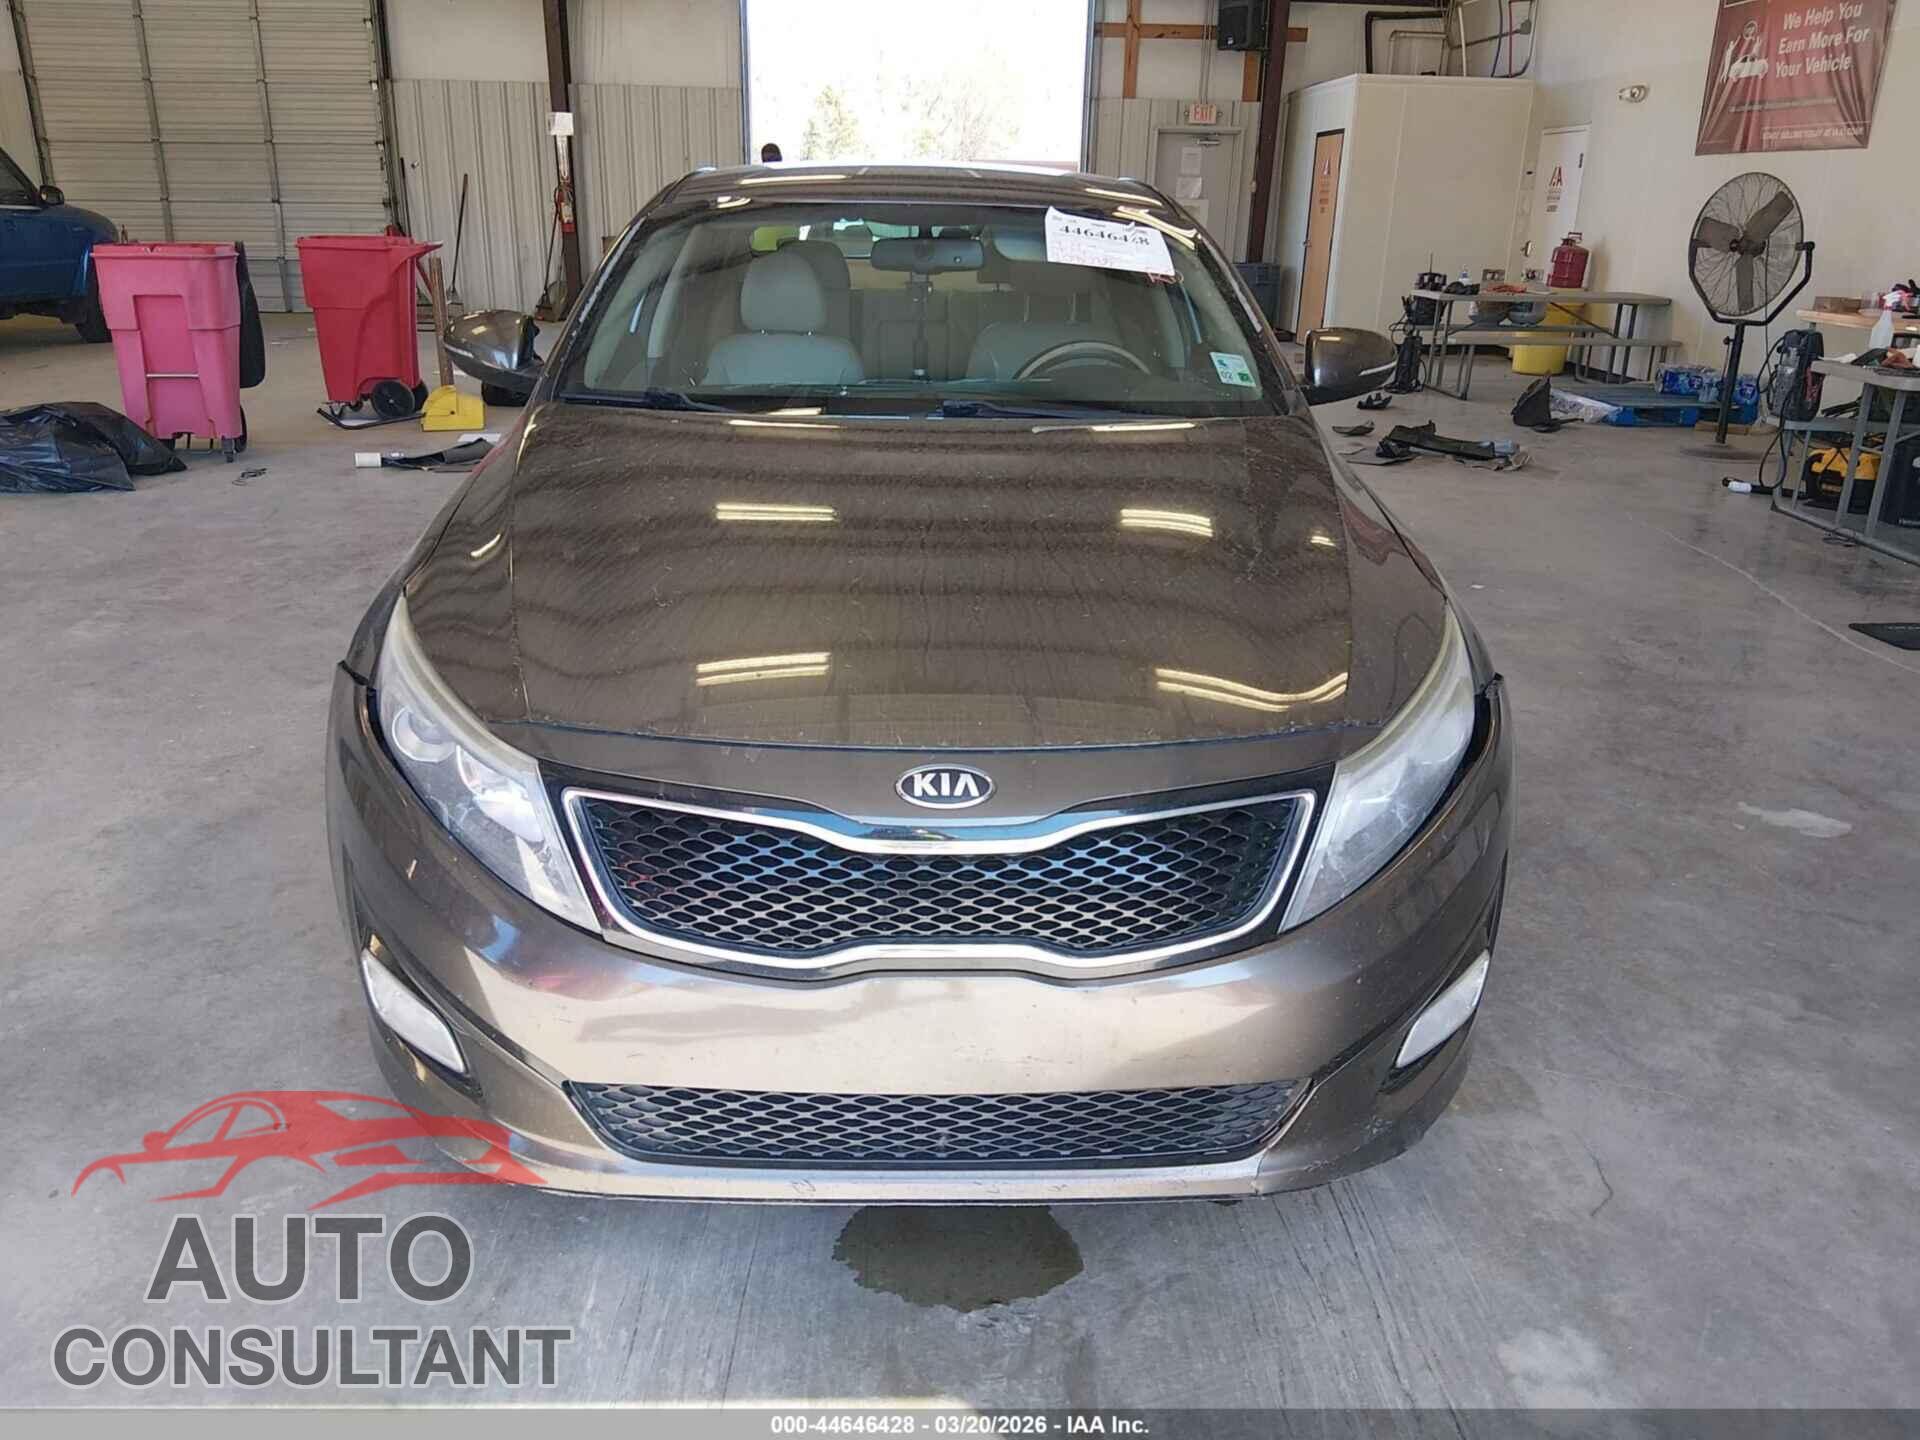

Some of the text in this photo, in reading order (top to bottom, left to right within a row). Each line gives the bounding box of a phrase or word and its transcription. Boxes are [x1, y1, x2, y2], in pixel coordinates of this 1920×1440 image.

[1783, 2, 1864, 30] We Help You
[1778, 25, 1871, 54] Earn More For
[1775, 61, 1802, 78] Your
[1193, 104, 1213, 121] EXIT
[913, 772, 980, 797] KIA
